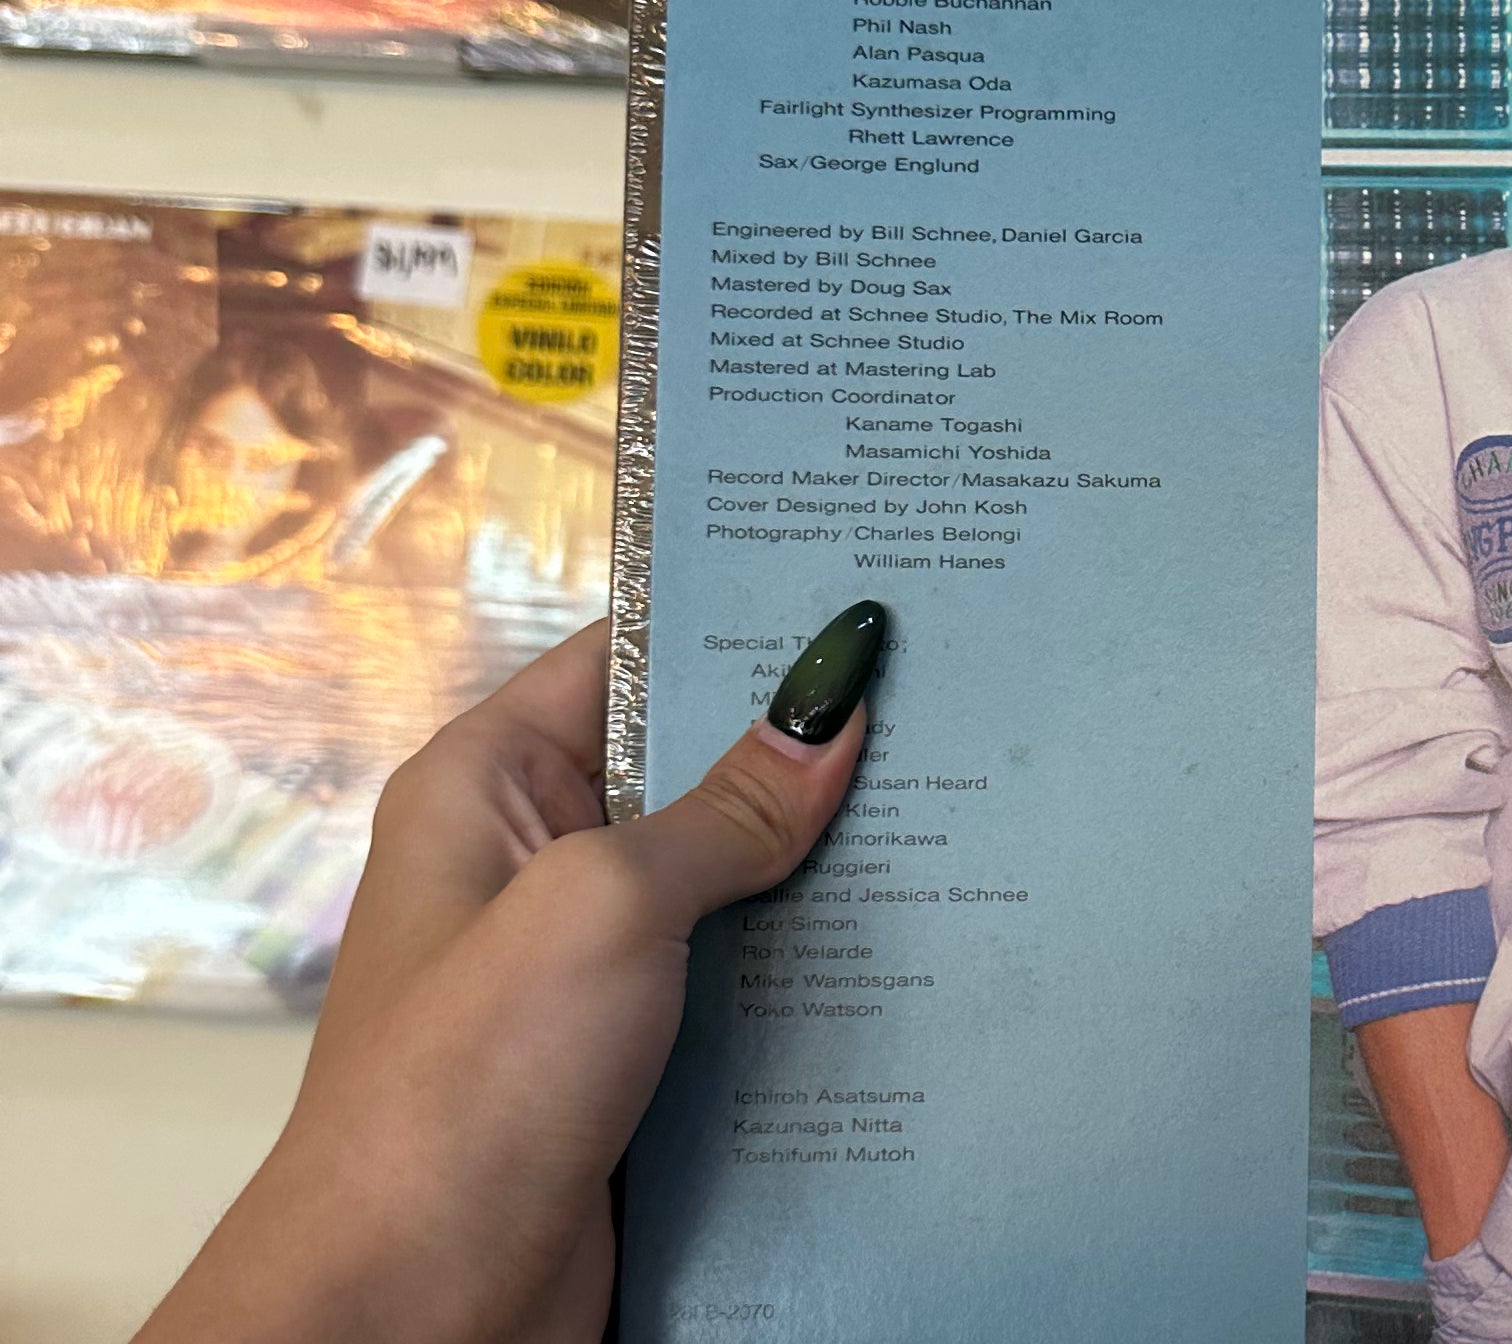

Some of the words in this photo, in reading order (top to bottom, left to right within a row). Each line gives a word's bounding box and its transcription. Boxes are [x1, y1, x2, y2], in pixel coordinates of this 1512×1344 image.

[852, 16, 892, 34] Phil
[898, 18, 953, 36] Nash
[851, 44, 901, 61] Alan
[906, 45, 986, 66] Pasqua
[851, 72, 963, 91] Kazumasa
[967, 75, 1013, 92] Oda
[759, 98, 845, 120] Fairlight
[850, 101, 974, 121] Synthesizer
[979, 104, 1117, 126] Programming
[847, 127, 906, 146] Rhett
[911, 129, 1015, 148] Lawrence
[893, 156, 980, 176] Englund
[711, 220, 832, 241] Engineered
[837, 223, 865, 244] by
[870, 224, 905, 241] Bill
[911, 225, 998, 244] Schnee,
[1002, 226, 1067, 245] Daniel
[1073, 227, 1144, 245] Garcia
[710, 248, 776, 266] Mixed
[782, 250, 809, 270] by
[814, 250, 850, 268] Bill
[855, 251, 937, 269] Schnee
[710, 275, 811, 294] Mastered
[816, 277, 844, 298] by
[848, 278, 906, 299] Doug
[911, 279, 953, 297] Sax
[710, 302, 814, 322] Recorded
[819, 307, 842, 322] at
[847, 305, 930, 324] Schnee
[934, 307, 1008, 327] Studio,
[1011, 308, 1053, 326] The
[1059, 309, 1097, 326] Mix
[1103, 309, 1164, 327] Room
[709, 330, 775, 348] Mixed
[780, 333, 804, 348] at
[808, 332, 891, 350] Schnee
[896, 333, 965, 352] Studio
[708, 358, 810, 376] Mastered
[815, 361, 838, 377] at
[844, 360, 950, 382] Mastering
[956, 362, 997, 379] Lab
[707, 385, 824, 404] Production
[829, 387, 957, 406] Coordinator
[845, 415, 934, 433] Kaname
[939, 416, 1023, 436] Togashi
[844, 443, 961, 461] Masamichi
[967, 444, 1052, 461] Yoshida
[706, 468, 784, 486] Record
[791, 469, 861, 487] Maker
[1075, 472, 1162, 489] Sakuma
[705, 495, 770, 513] Cover
[775, 497, 877, 517] Designed
[883, 498, 910, 518] by
[914, 498, 967, 515] John
[973, 499, 1028, 516] Kosh
[941, 526, 1022, 545] Belongi
[852, 553, 932, 570] William
[938, 553, 1007, 570] Hanes
[702, 634, 785, 654] Special
[853, 774, 919, 791] Susan
[925, 775, 988, 791] Heard
[846, 803, 900, 819] Klein
[824, 830, 949, 847] Minorikawa
[803, 858, 891, 878] Ruggieri
[811, 887, 852, 903] and
[858, 887, 941, 904] Jessica
[947, 886, 1029, 903] Schnee
[792, 916, 858, 932] Simon
[793, 944, 874, 960] Velarde
[803, 973, 935, 992] Wambsgans
[802, 1002, 883, 1018] Watson
[735, 1089, 809, 1105] Ichiroh
[816, 1088, 926, 1105] Asatsuma
[733, 1119, 844, 1138] Kazunaga
[851, 1117, 903, 1134] Nitta
[732, 1147, 838, 1164] Toshifumi
[845, 1145, 916, 1163] Mutoh
